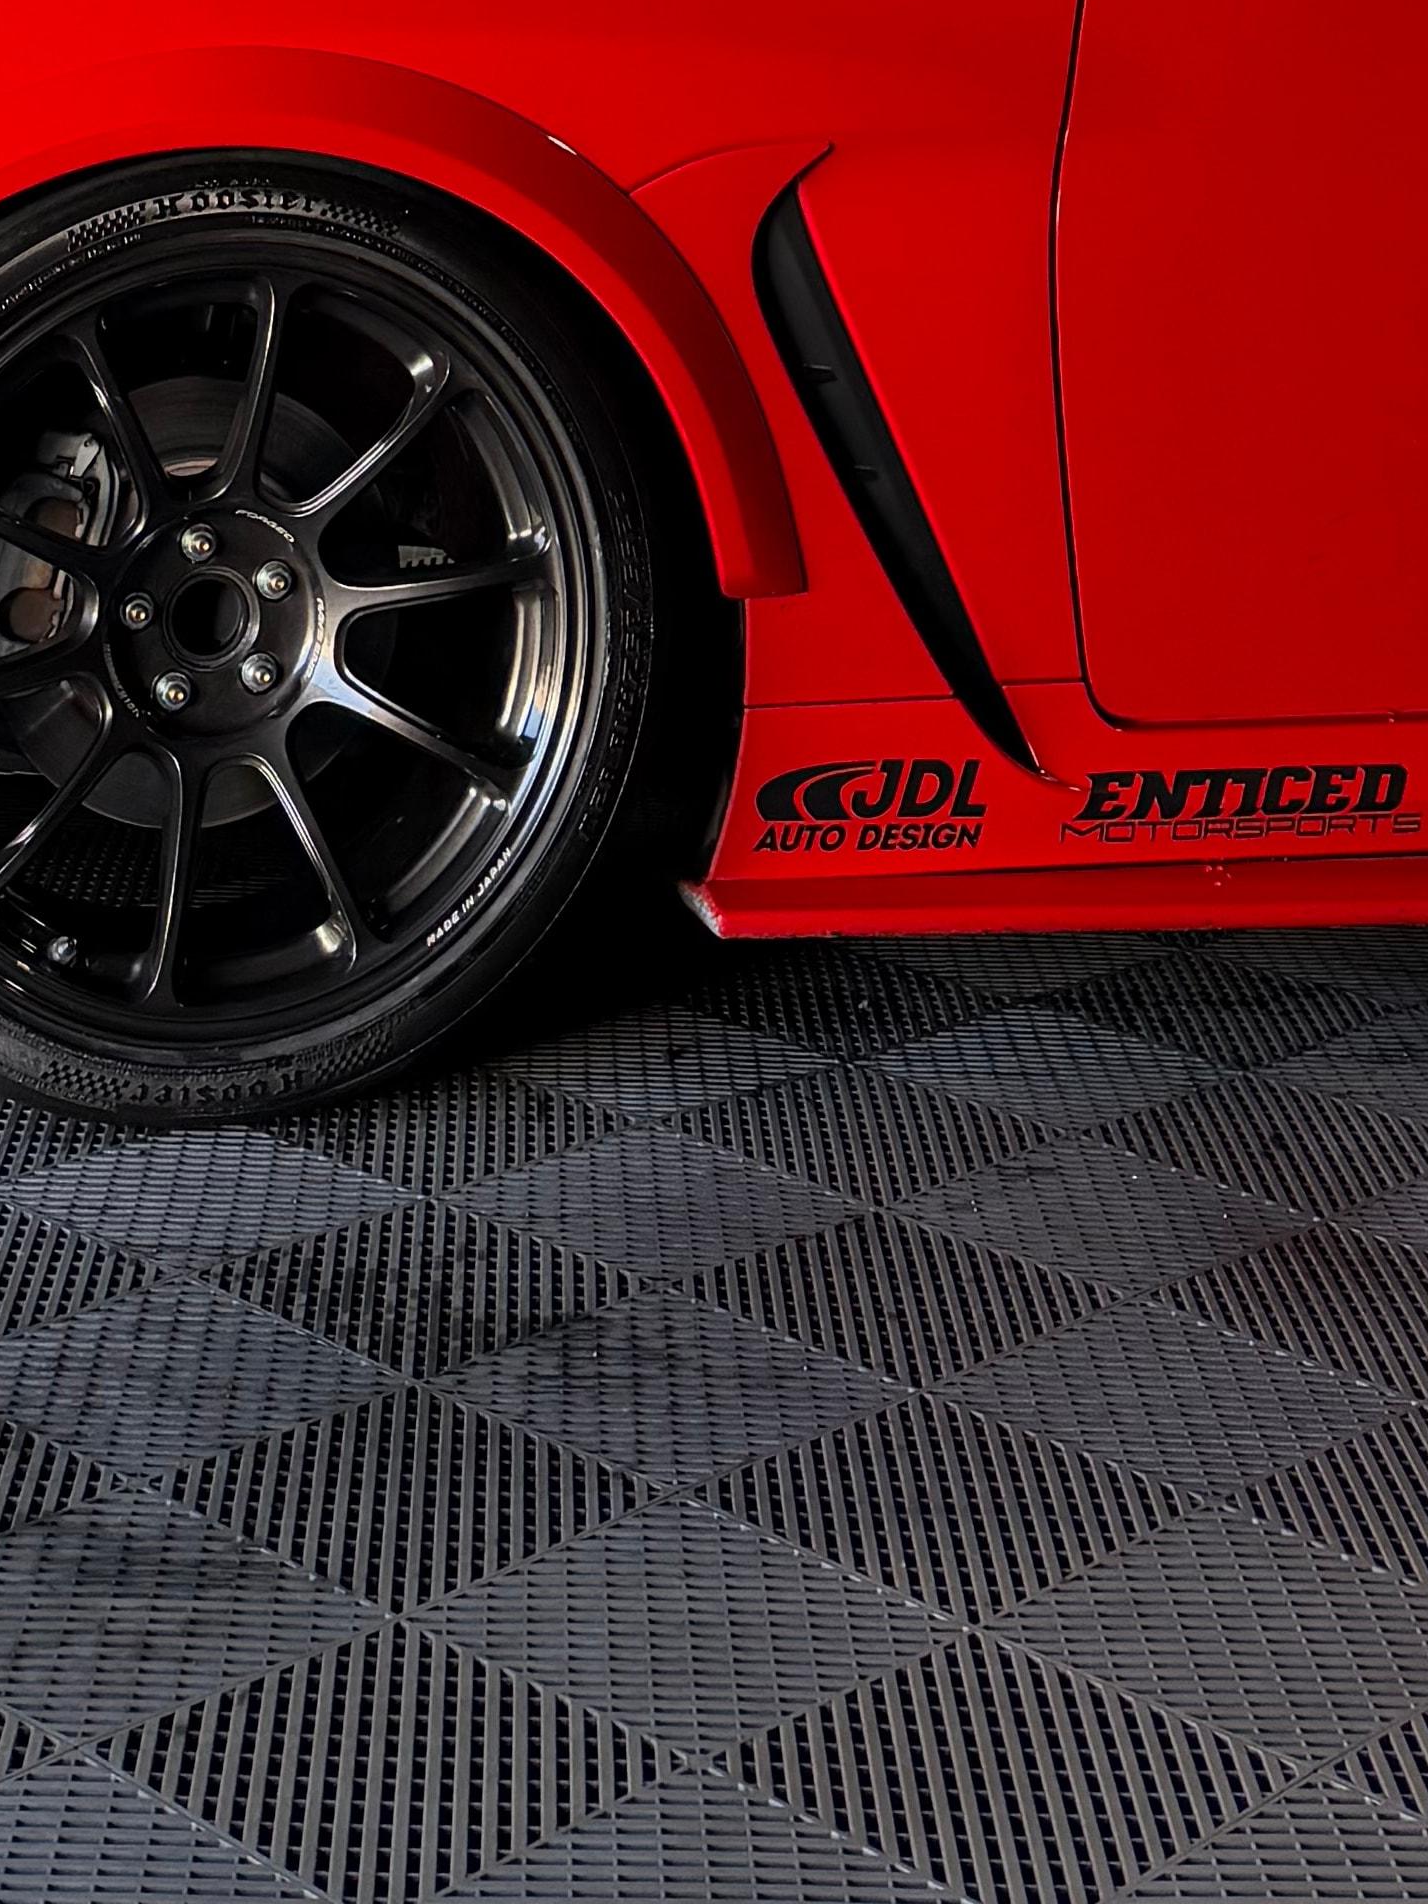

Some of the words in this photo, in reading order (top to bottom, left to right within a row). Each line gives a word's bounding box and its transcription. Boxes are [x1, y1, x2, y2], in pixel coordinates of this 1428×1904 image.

[152, 191, 315, 221] Hoosier
[234, 508, 296, 543] FORGED
[849, 759, 989, 819] JDL
[1082, 763, 1409, 821] ENTICED
[753, 823, 846, 853] AUTO
[856, 822, 982, 851] DESIGN
[1059, 813, 1422, 844] MOTORSPORTS
[425, 909, 461, 948] MADE
[461, 894, 475, 914] IN
[476, 846, 512, 897] JAPAN
[133, 1069, 305, 1105] Hoosier
